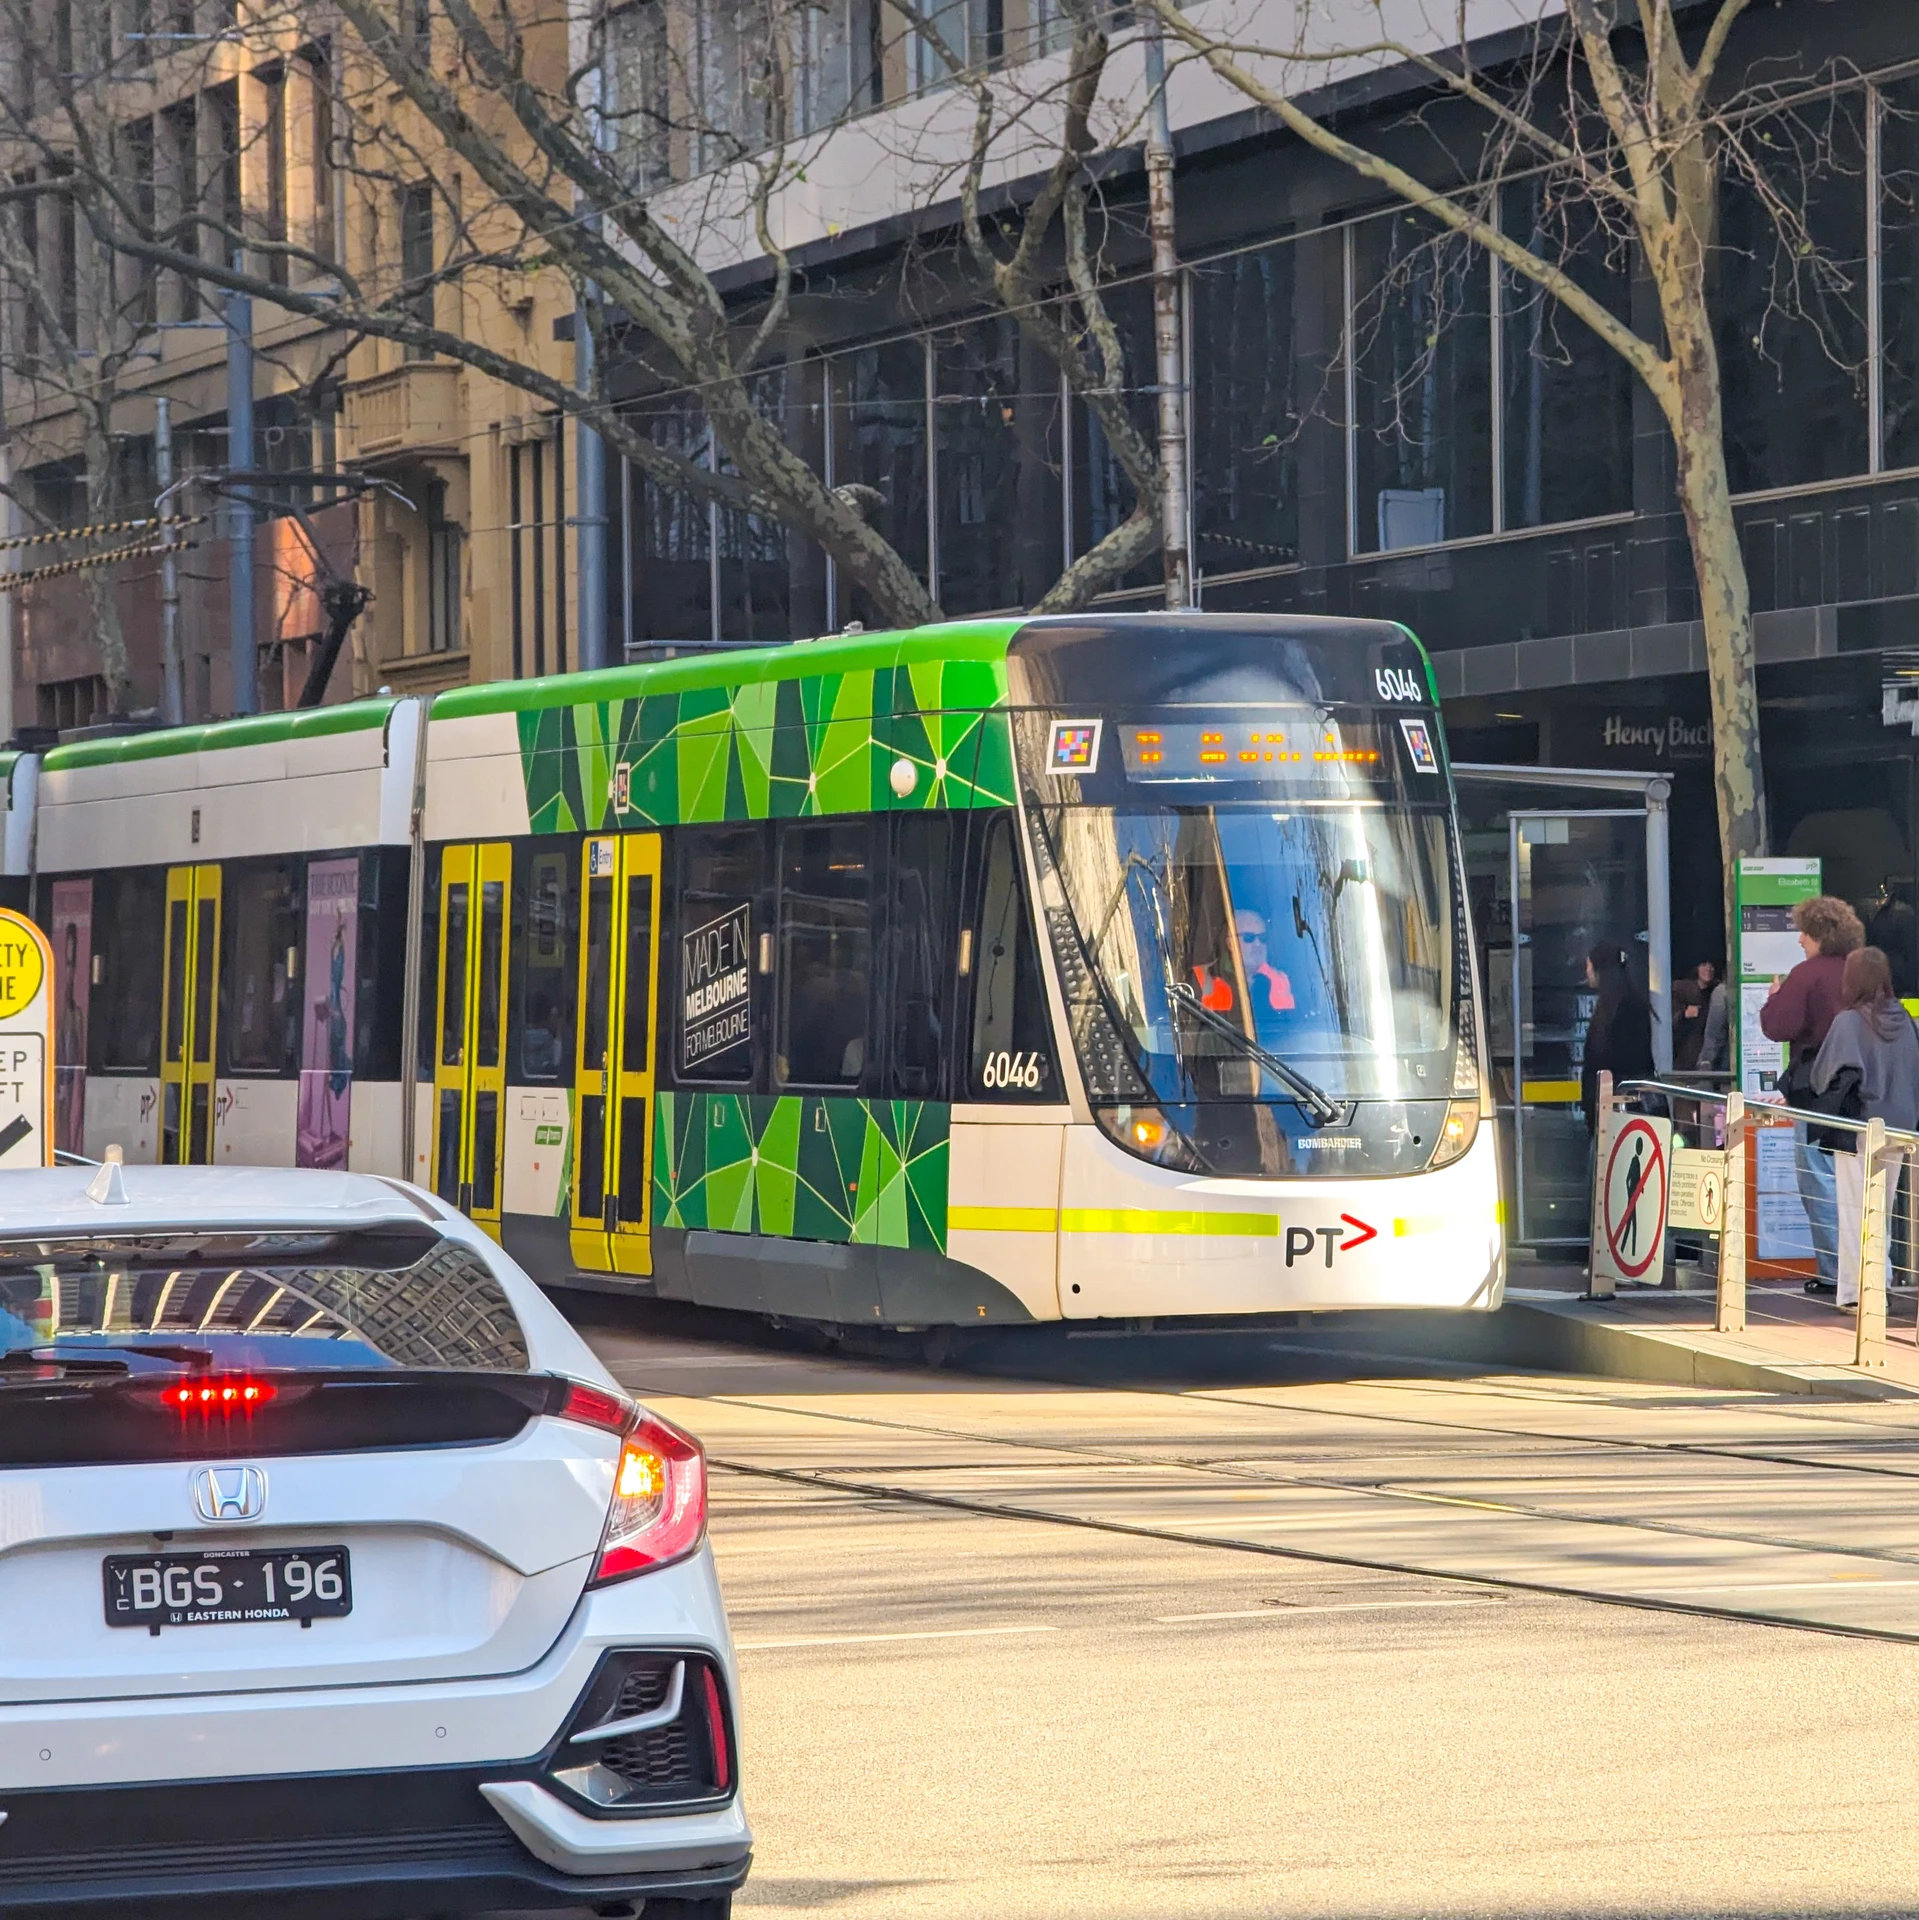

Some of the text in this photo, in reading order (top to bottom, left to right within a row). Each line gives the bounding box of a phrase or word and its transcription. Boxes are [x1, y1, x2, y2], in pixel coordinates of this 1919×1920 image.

[1375, 668, 1422, 702] 6046
[1603, 715, 1666, 756] Henry
[599, 849, 612, 868] Entry
[0, 944, 27, 967] TY
[685, 913, 748, 989] MADE IN
[686, 967, 748, 1021] MELBOURNE
[686, 1009, 748, 1059] FOR MELBOURNE
[983, 1051, 1039, 1088] 6046
[1298, 1138, 1361, 1149] BOMBARDIER
[203, 1551, 250, 1559] DONCASTER
[115, 1569, 130, 1611] VIC
[132, 1559, 343, 1610] BGS 196
[187, 1608, 290, 1622] EASTERN HONDA
